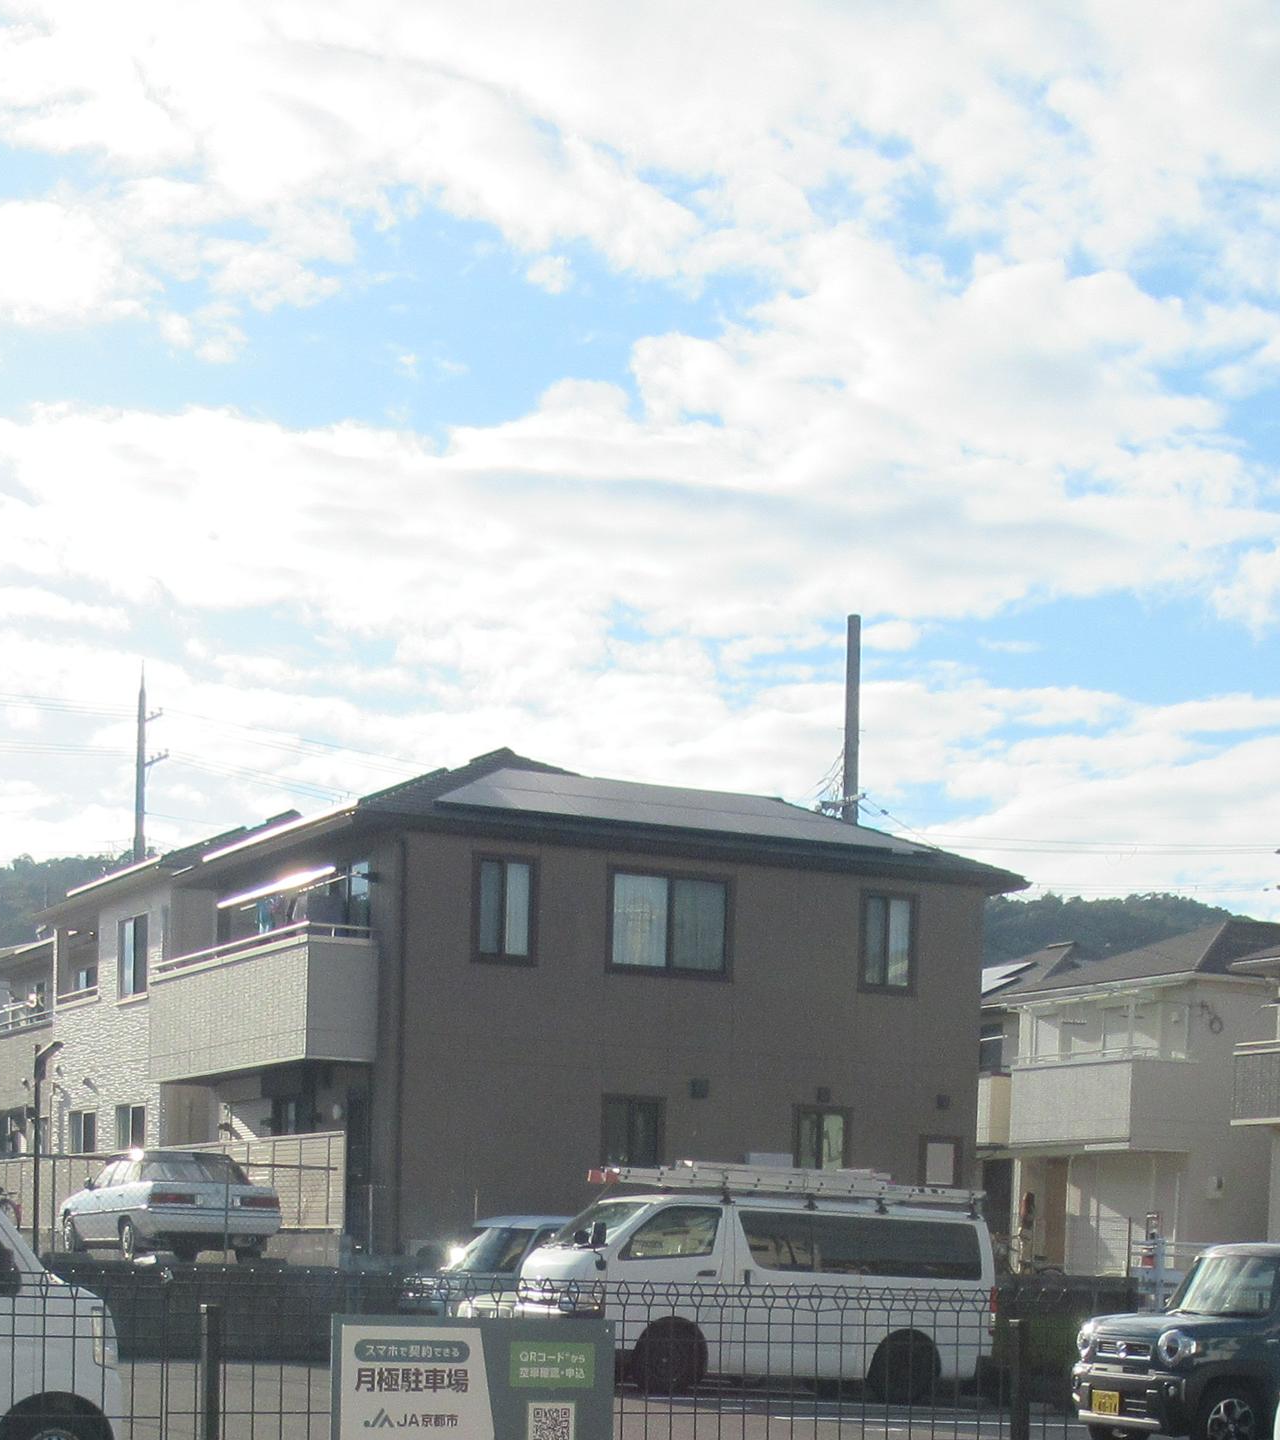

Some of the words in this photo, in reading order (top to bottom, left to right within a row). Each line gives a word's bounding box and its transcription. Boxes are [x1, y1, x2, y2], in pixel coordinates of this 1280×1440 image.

[365, 1344, 460, 1358] スマホで契約できる
[354, 1367, 469, 1393] 月極駐車場
[397, 1413, 459, 1428] JA京都市
